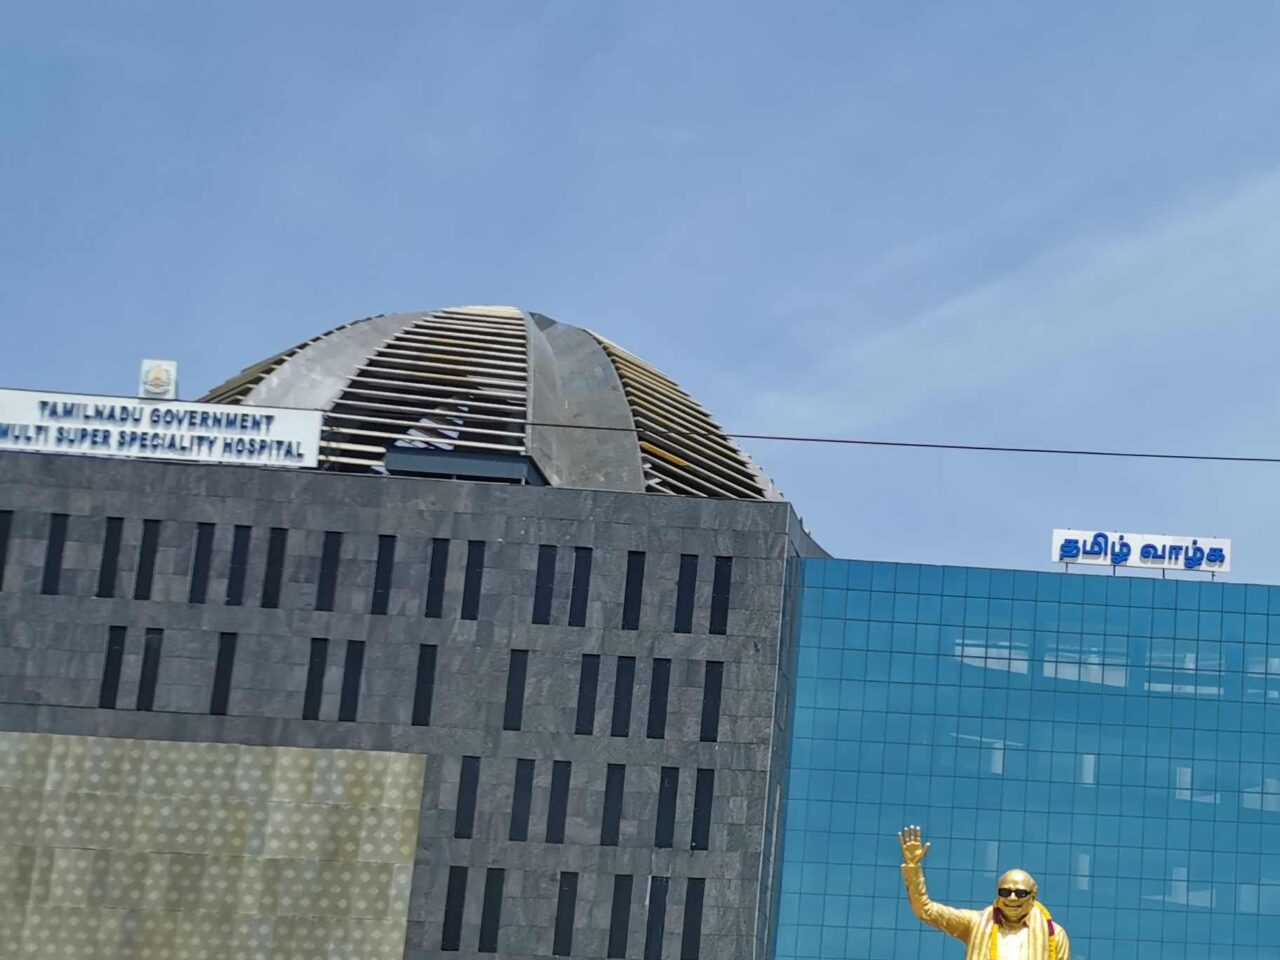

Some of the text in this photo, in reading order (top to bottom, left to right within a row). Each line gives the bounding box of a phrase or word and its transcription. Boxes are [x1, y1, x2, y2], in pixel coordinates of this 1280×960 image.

[39, 400, 274, 433] TAMILNADU GOVERNMENT
[0, 423, 304, 459] MULTI SUPER SPECIALITY HOSPITAL
[1060, 532, 1225, 568] தமிழ் வாழ்க
